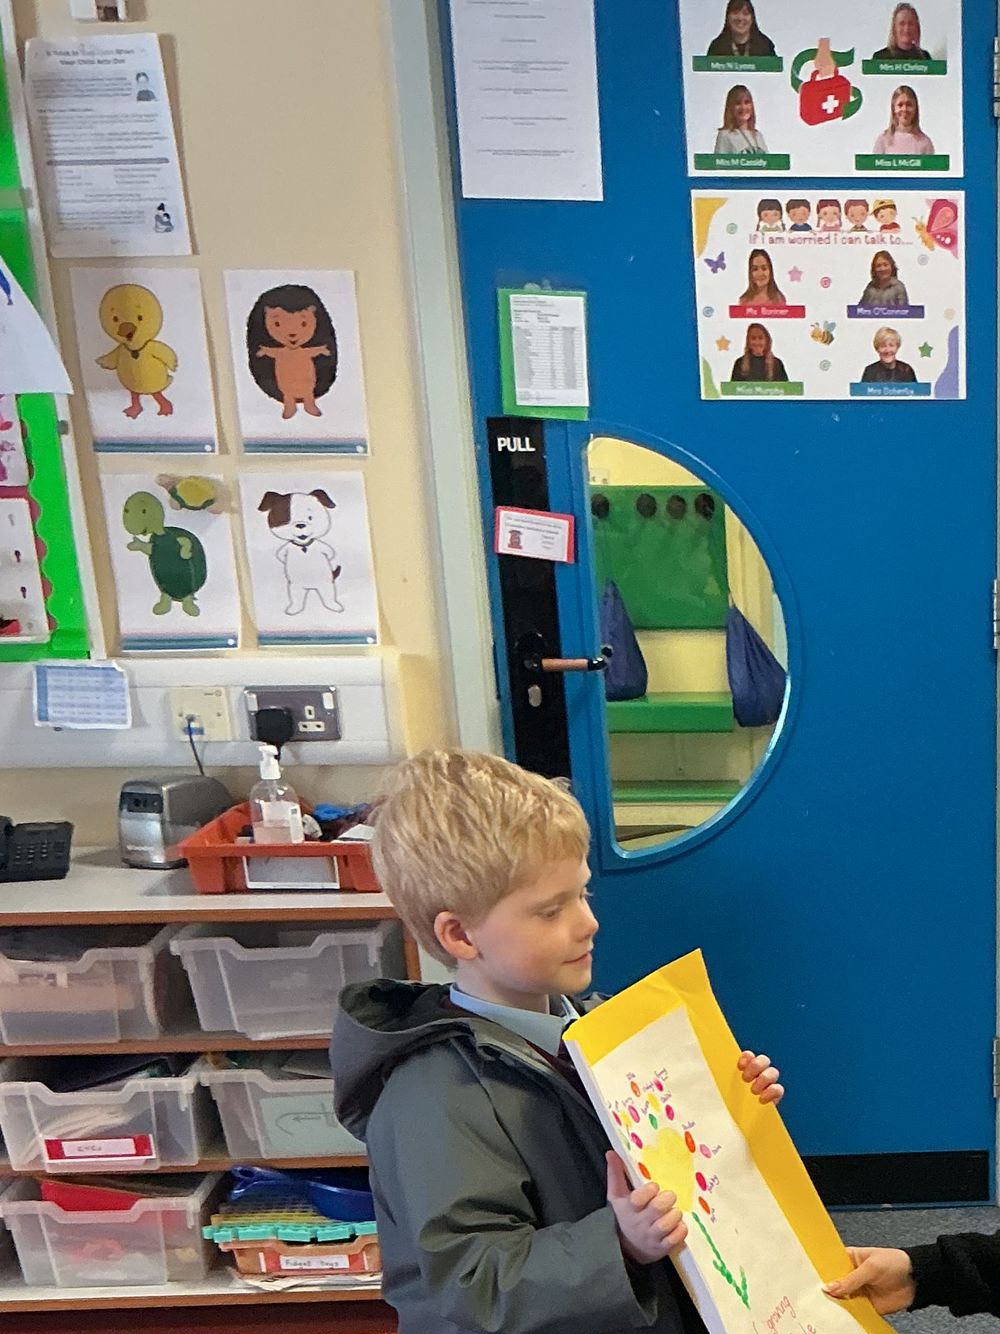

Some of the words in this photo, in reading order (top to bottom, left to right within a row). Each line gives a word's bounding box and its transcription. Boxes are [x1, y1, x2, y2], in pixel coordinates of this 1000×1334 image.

[768, 236, 785, 244] am
[788, 233, 831, 245] worried
[841, 235, 862, 245] can
[864, 233, 887, 245] talk
[497, 437, 536, 452] PULL
